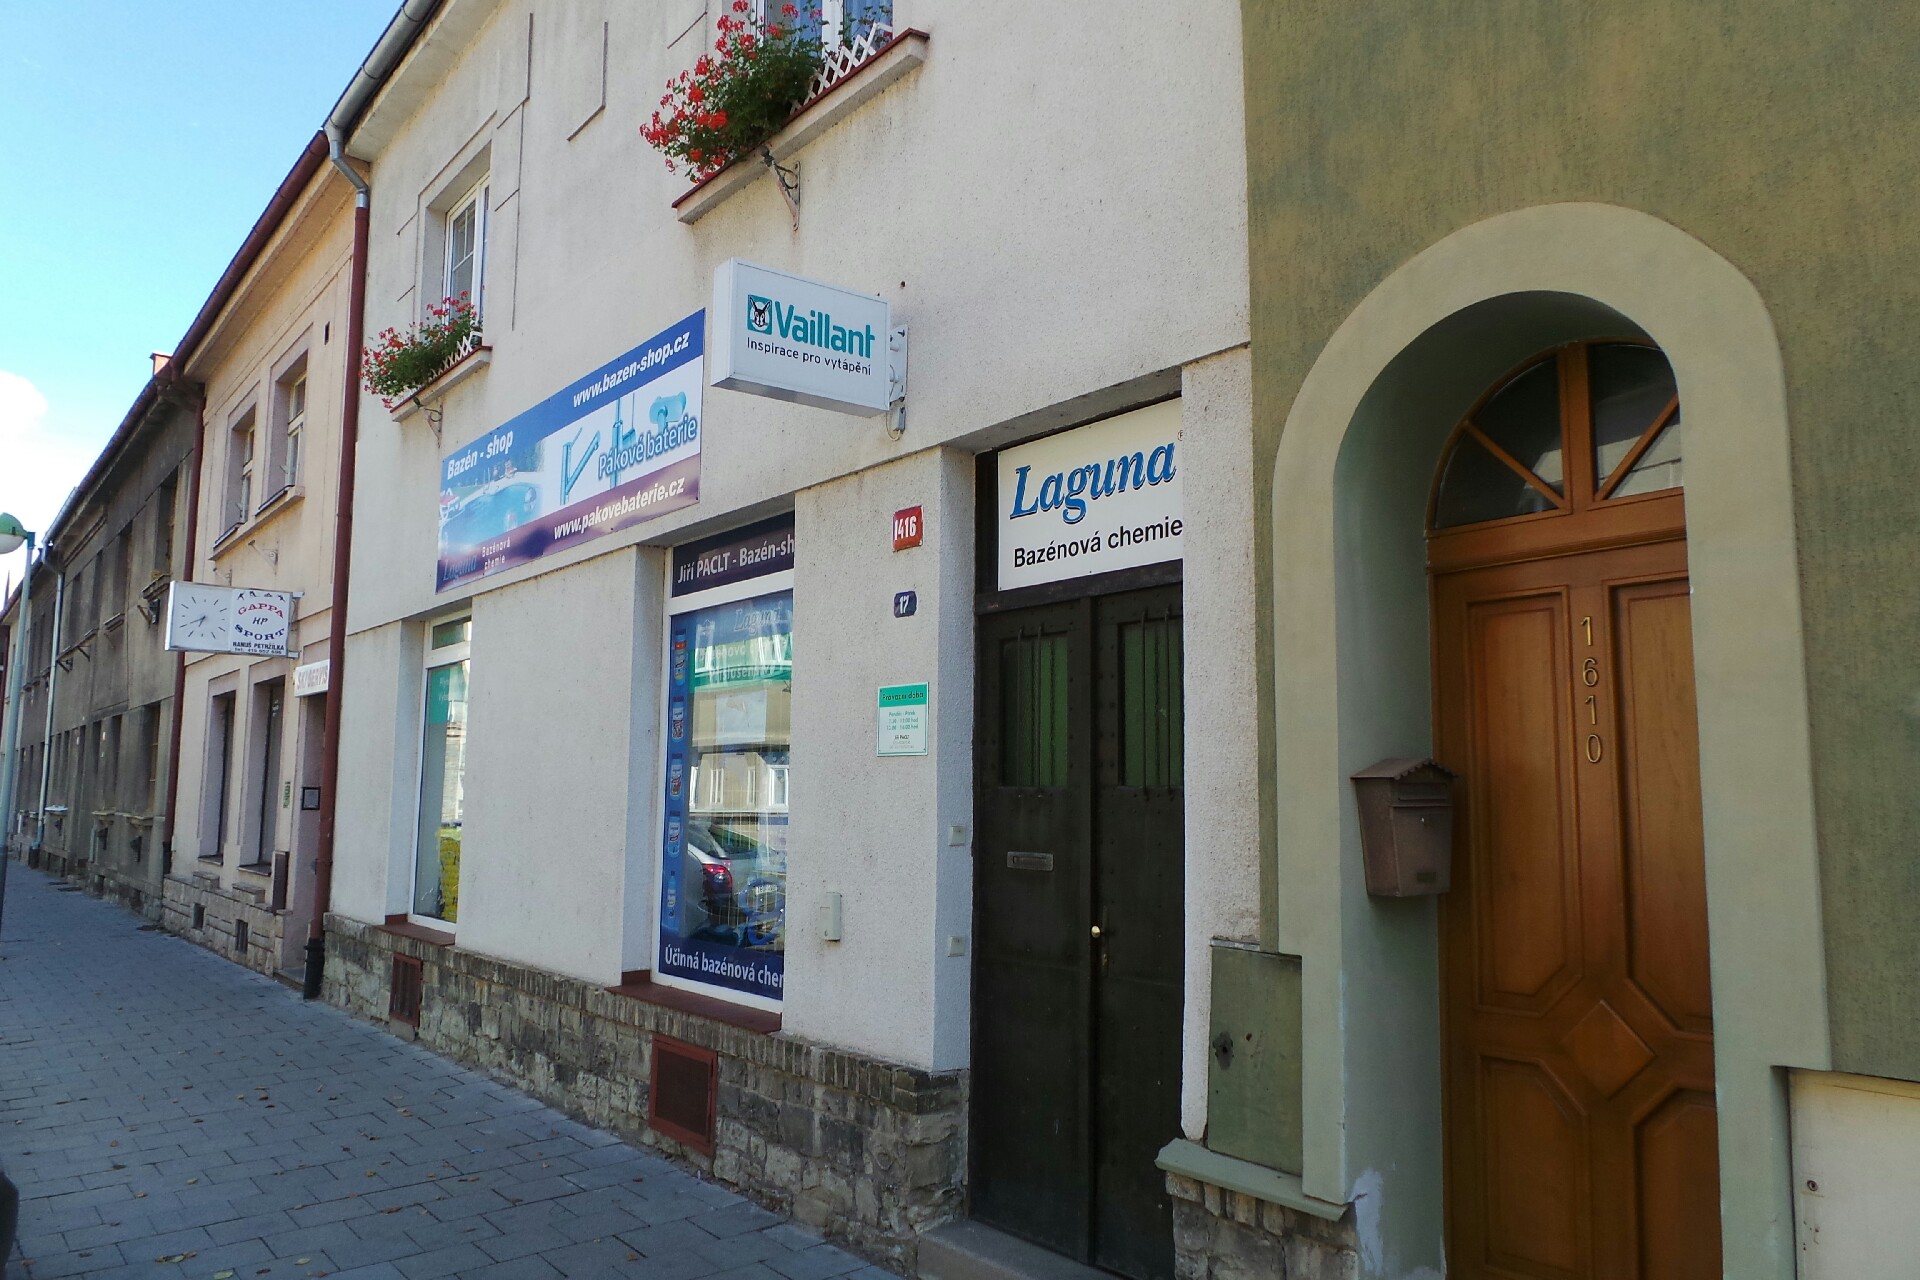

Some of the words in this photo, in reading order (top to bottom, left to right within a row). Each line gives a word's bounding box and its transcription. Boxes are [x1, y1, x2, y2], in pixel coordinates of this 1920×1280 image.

[775, 301, 875, 359] Vaillant
[572, 330, 691, 408] www.bazen-shop.cz
[747, 337, 799, 359] Inspirace
[802, 352, 821, 364] pro
[824, 357, 871, 376] vytápění
[447, 451, 478, 480] Bazén
[486, 429, 514, 458] shop
[597, 435, 645, 480] Pákové
[645, 413, 698, 459] baterie
[1009, 441, 1178, 525] Laguna
[553, 477, 686, 541] www.pakovebaterie.cz
[894, 515, 916, 541] 1416
[1014, 530, 1101, 568] Bazénová
[1107, 516, 1183, 549] chemie
[481, 536, 511, 558] Bazénová
[484, 554, 506, 571] chemie
[677, 562, 695, 584] Jiří
[696, 551, 731, 578] PACLT
[238, 602, 284, 619] GAPPA
[252, 616, 269, 625] HP
[898, 594, 909, 615] 17
[234, 623, 285, 641] SPORT
[908, 691, 924, 699] doba
[665, 943, 699, 970] Účinná
[701, 951, 755, 982] bazénová
